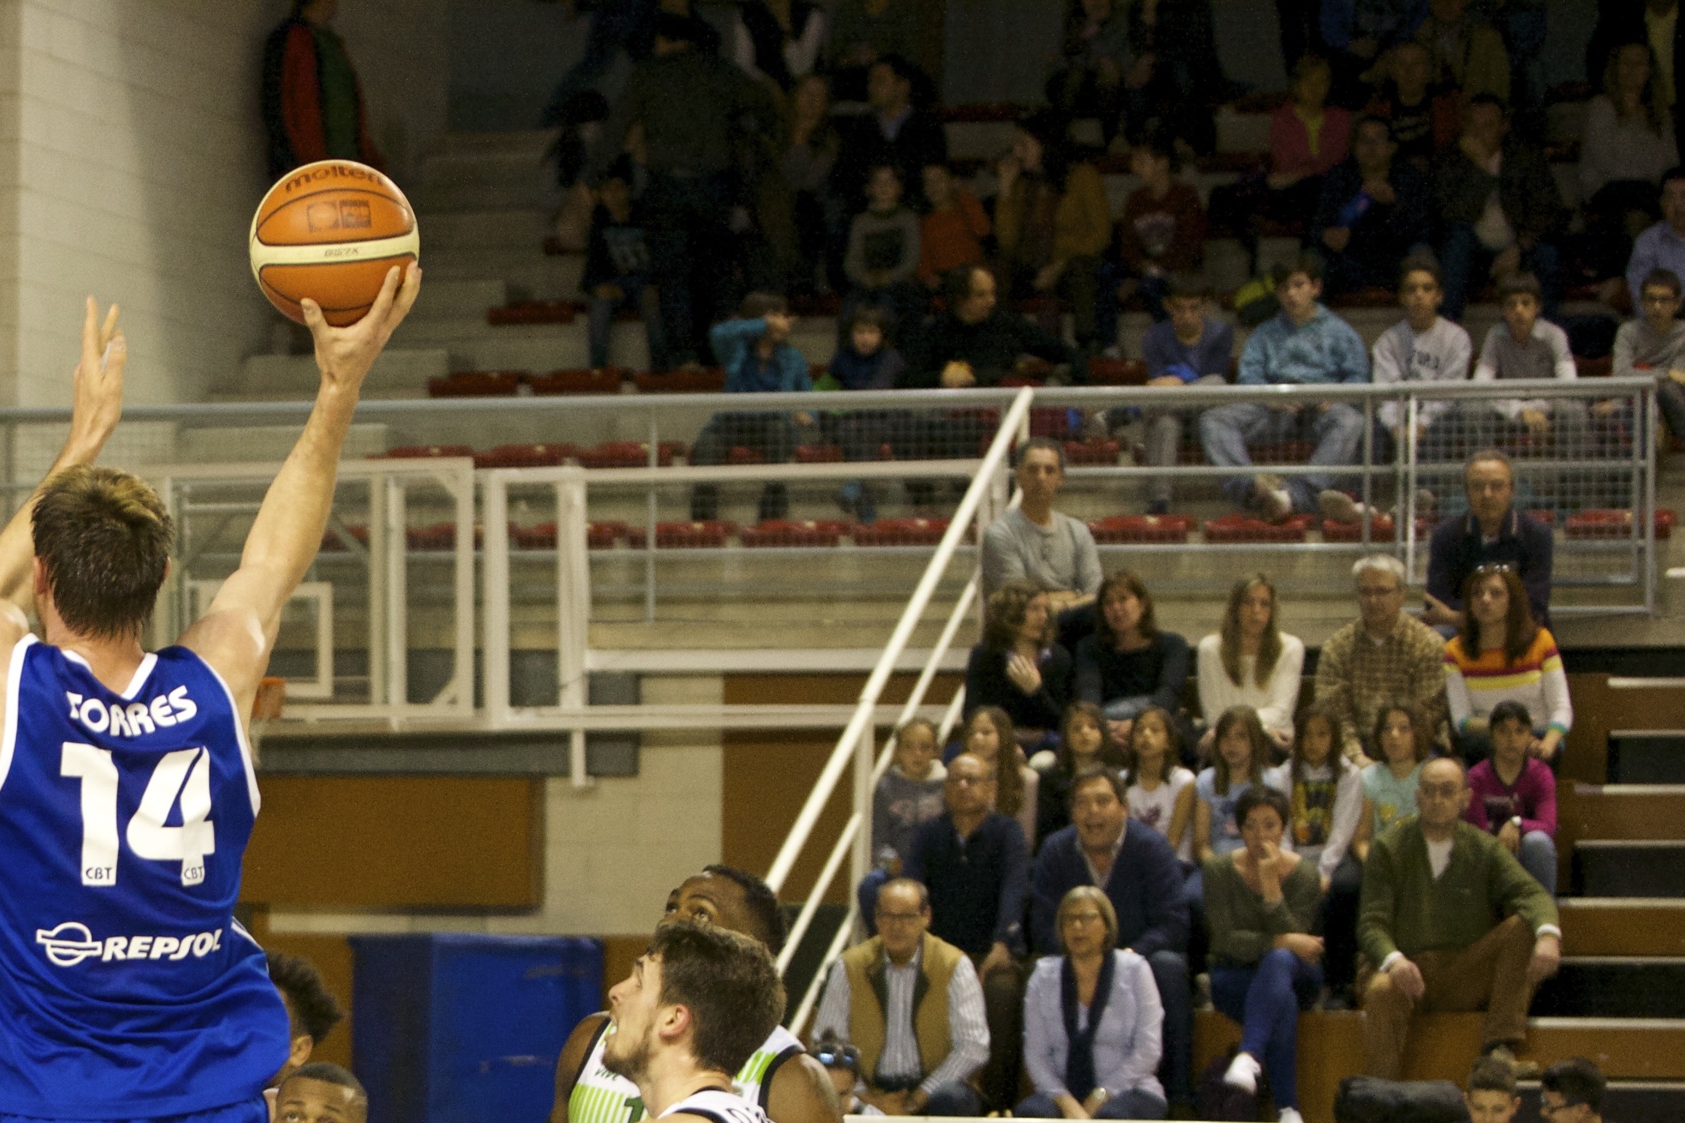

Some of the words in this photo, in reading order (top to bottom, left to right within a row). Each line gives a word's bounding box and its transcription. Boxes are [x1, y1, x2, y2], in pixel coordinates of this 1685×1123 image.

[285, 165, 383, 192] molten
[66, 685, 198, 737] TORRES
[61, 741, 215, 886] 14
[85, 866, 113, 880] CBT
[183, 865, 203, 880] CBT
[101, 928, 223, 962] REPSOL
